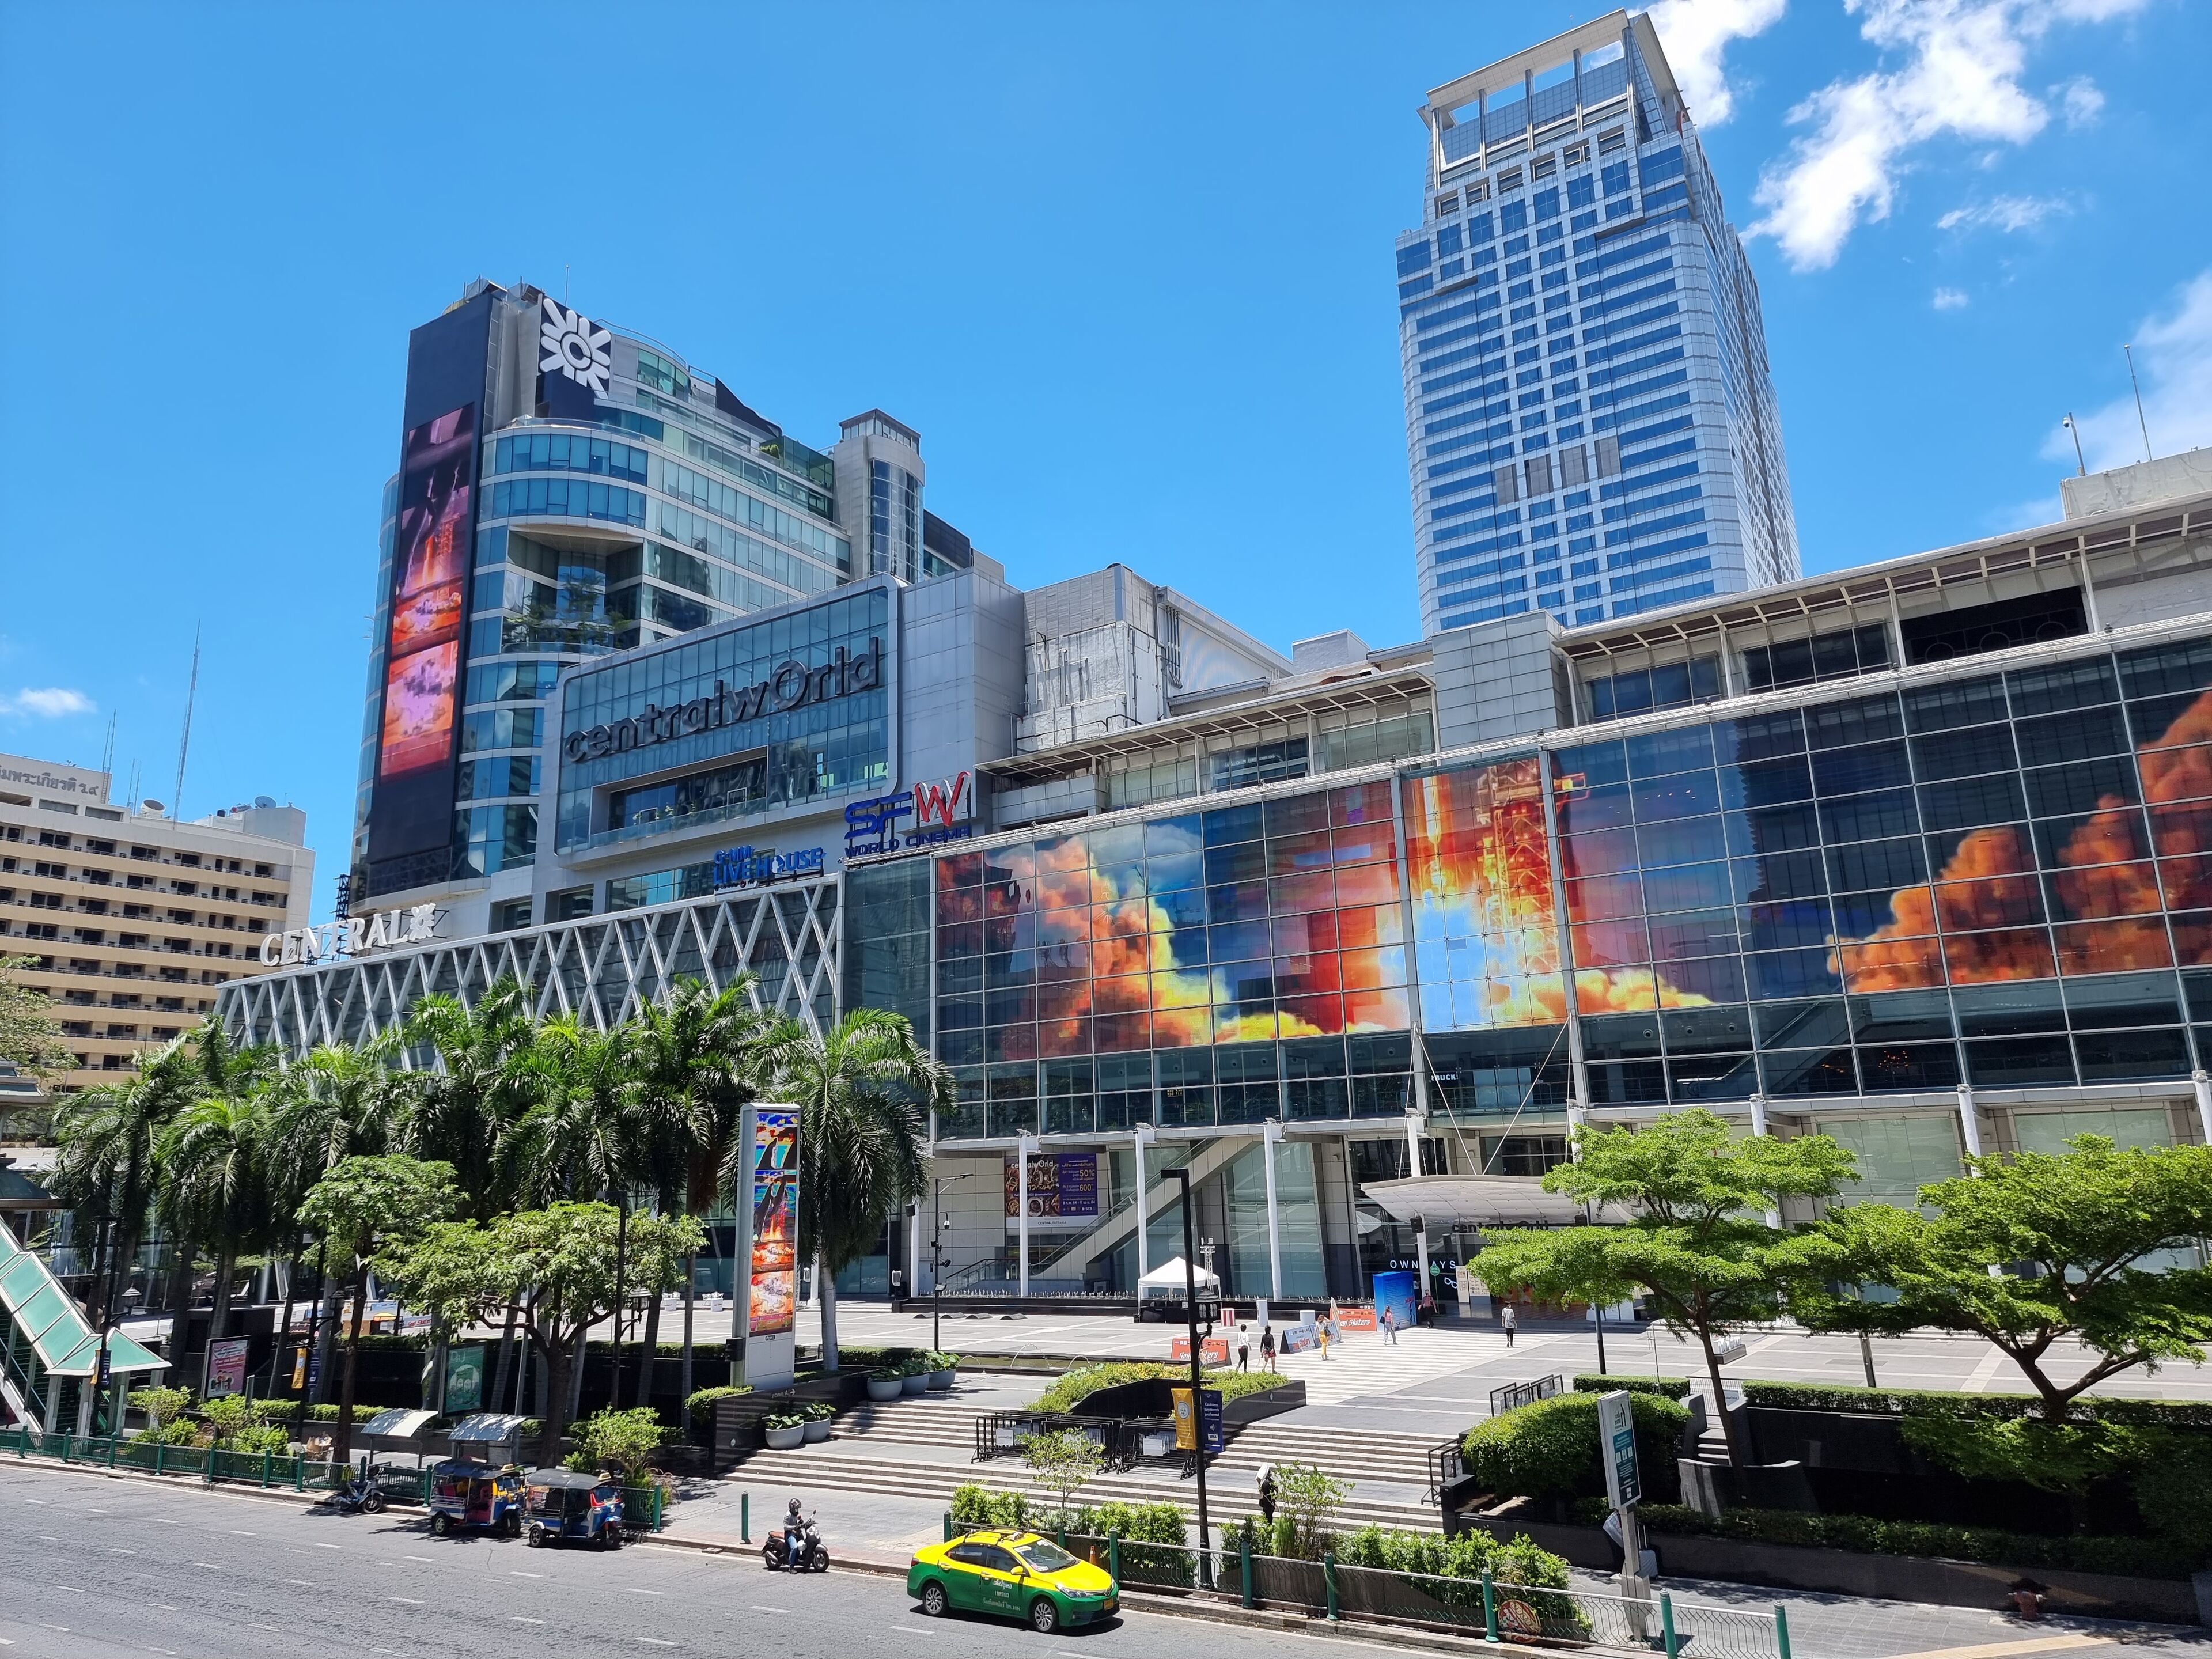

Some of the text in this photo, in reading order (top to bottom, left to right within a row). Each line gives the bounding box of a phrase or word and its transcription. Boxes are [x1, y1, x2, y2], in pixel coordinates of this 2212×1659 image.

[564, 636, 880, 762] centralwOrld
[844, 825, 971, 858] WORLD CINEMA
[713, 859, 752, 885] LIVE
[260, 909, 409, 967] CENTRAL
[1011, 1160, 1054, 1169] cealwOrld
[1080, 1169, 1095, 1177] 50%
[1389, 1260, 1456, 1270] OWNAYS
